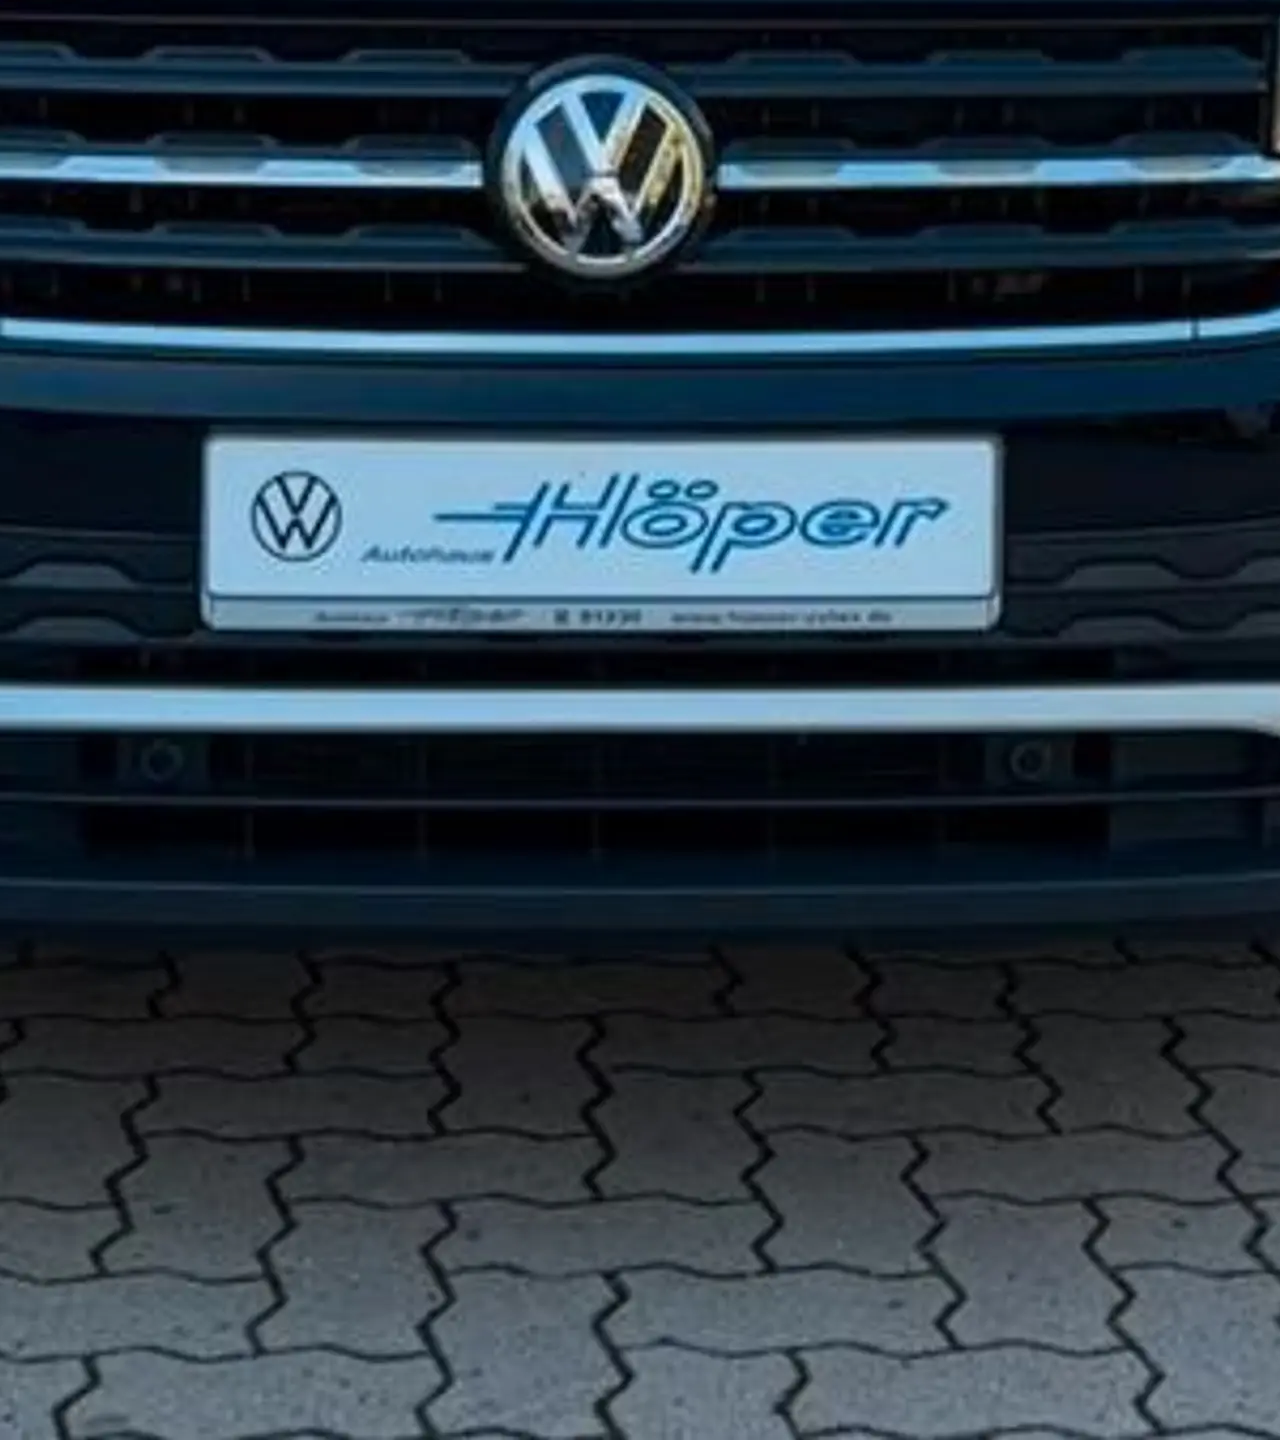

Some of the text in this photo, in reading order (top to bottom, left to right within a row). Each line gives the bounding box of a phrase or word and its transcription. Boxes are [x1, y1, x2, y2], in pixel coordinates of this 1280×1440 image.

[506, 78, 700, 272] VW
[253, 471, 341, 560] VW
[434, 472, 950, 574] Höper
